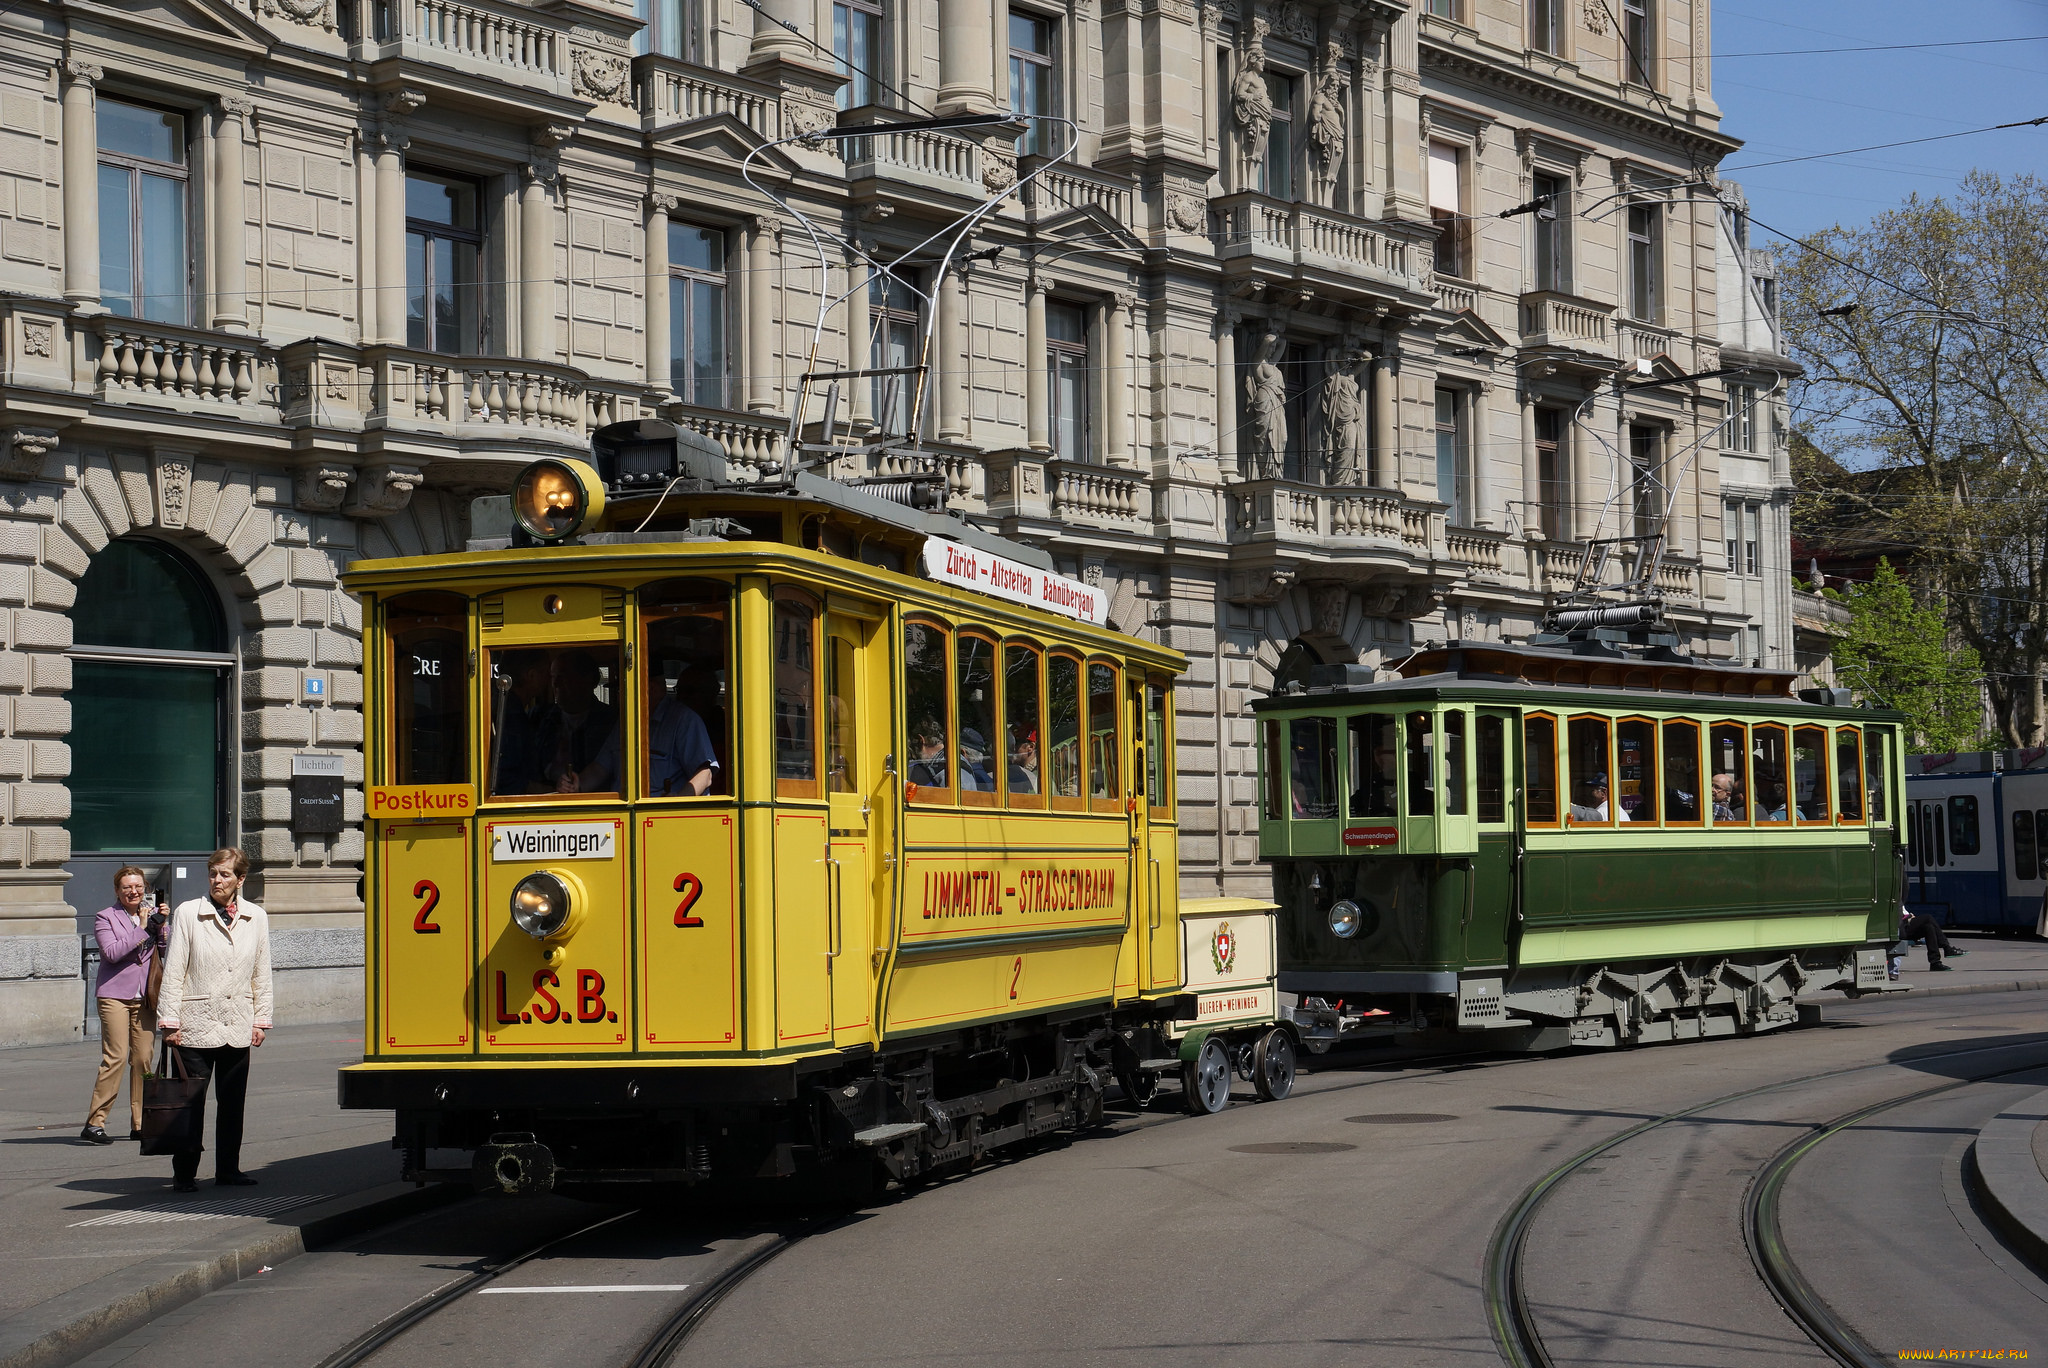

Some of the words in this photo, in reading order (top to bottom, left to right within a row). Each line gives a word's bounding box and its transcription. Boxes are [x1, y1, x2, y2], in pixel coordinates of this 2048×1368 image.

[946, 545, 977, 581] Zürich
[990, 559, 1032, 596] Altstetten
[1043, 575, 1095, 621] Bahnübergang
[312, 681, 319, 692] 8
[301, 759, 336, 770] lichthof
[373, 789, 469, 811] Postkurs
[506, 829, 600, 857] Weiningen
[1344, 832, 1396, 840] Schwamendingen
[412, 878, 441, 935] 2
[672, 871, 704, 929] 2
[1009, 956, 1022, 1000] 2
[495, 968, 618, 1025] L.S.B.
